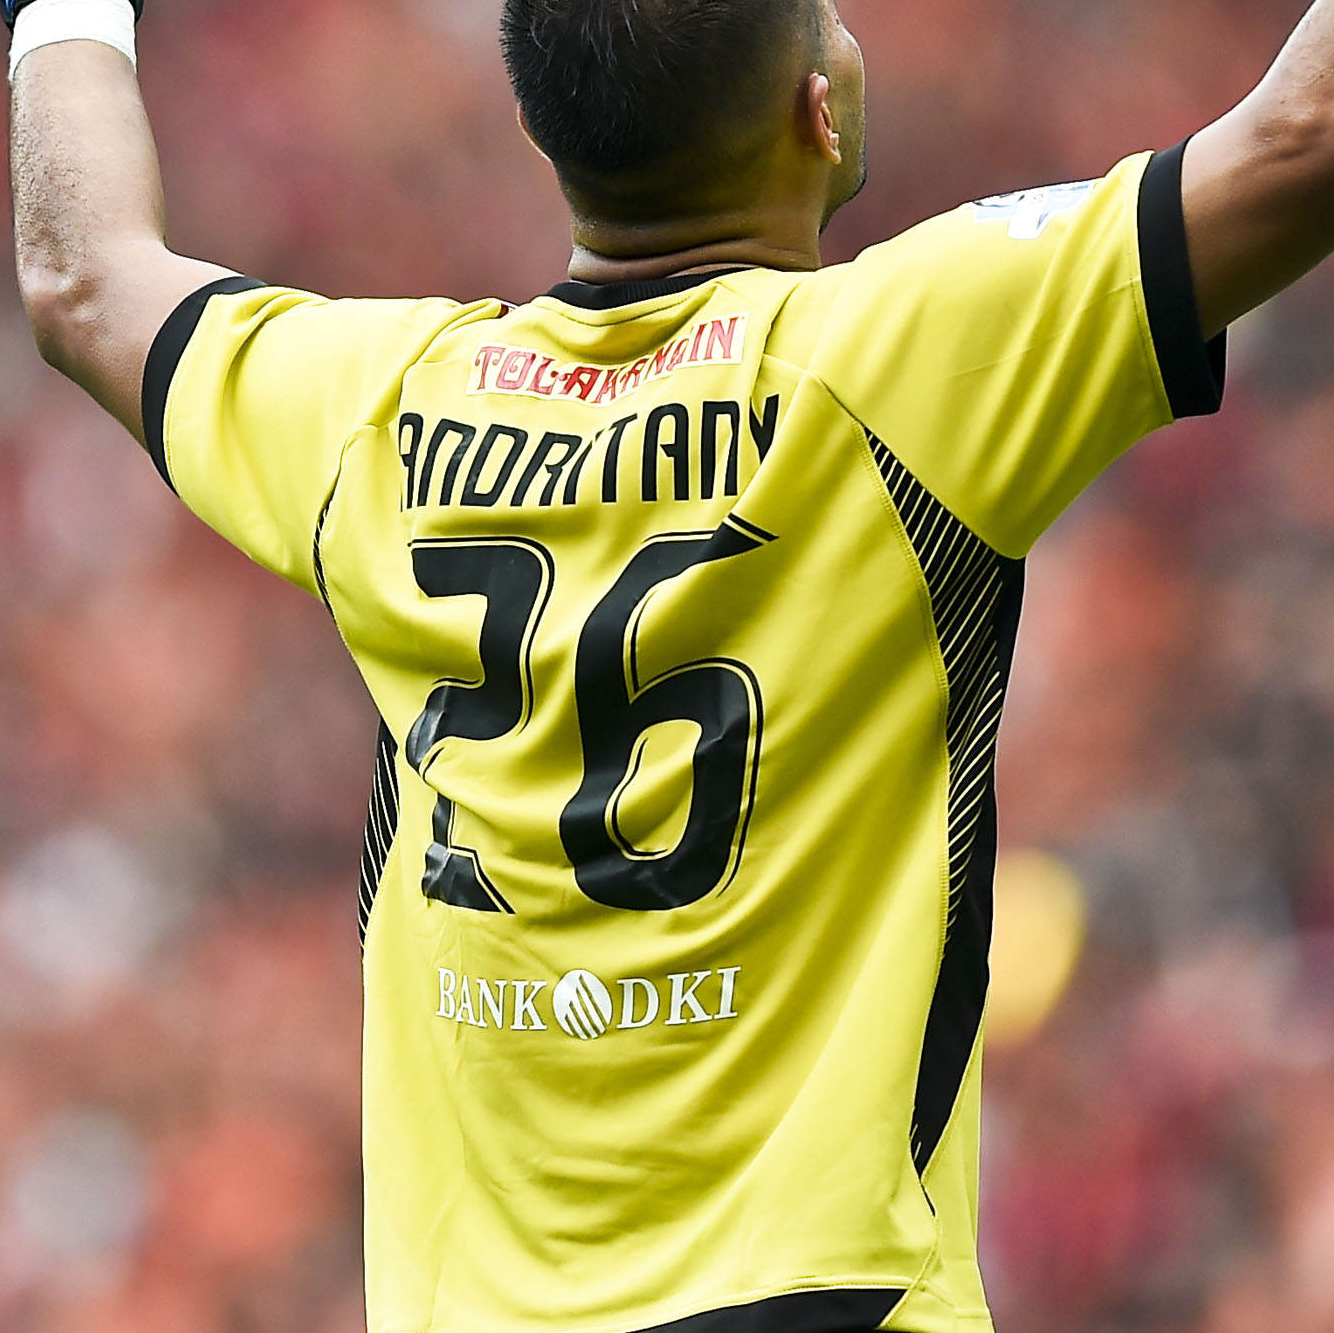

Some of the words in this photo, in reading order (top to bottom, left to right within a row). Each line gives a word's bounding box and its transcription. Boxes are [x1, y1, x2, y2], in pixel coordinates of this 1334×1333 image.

[400, 394, 780, 512] ANDRITANY
[406, 513, 779, 914] 26
[435, 966, 547, 1030] BANK
[616, 966, 742, 1030] DKI
